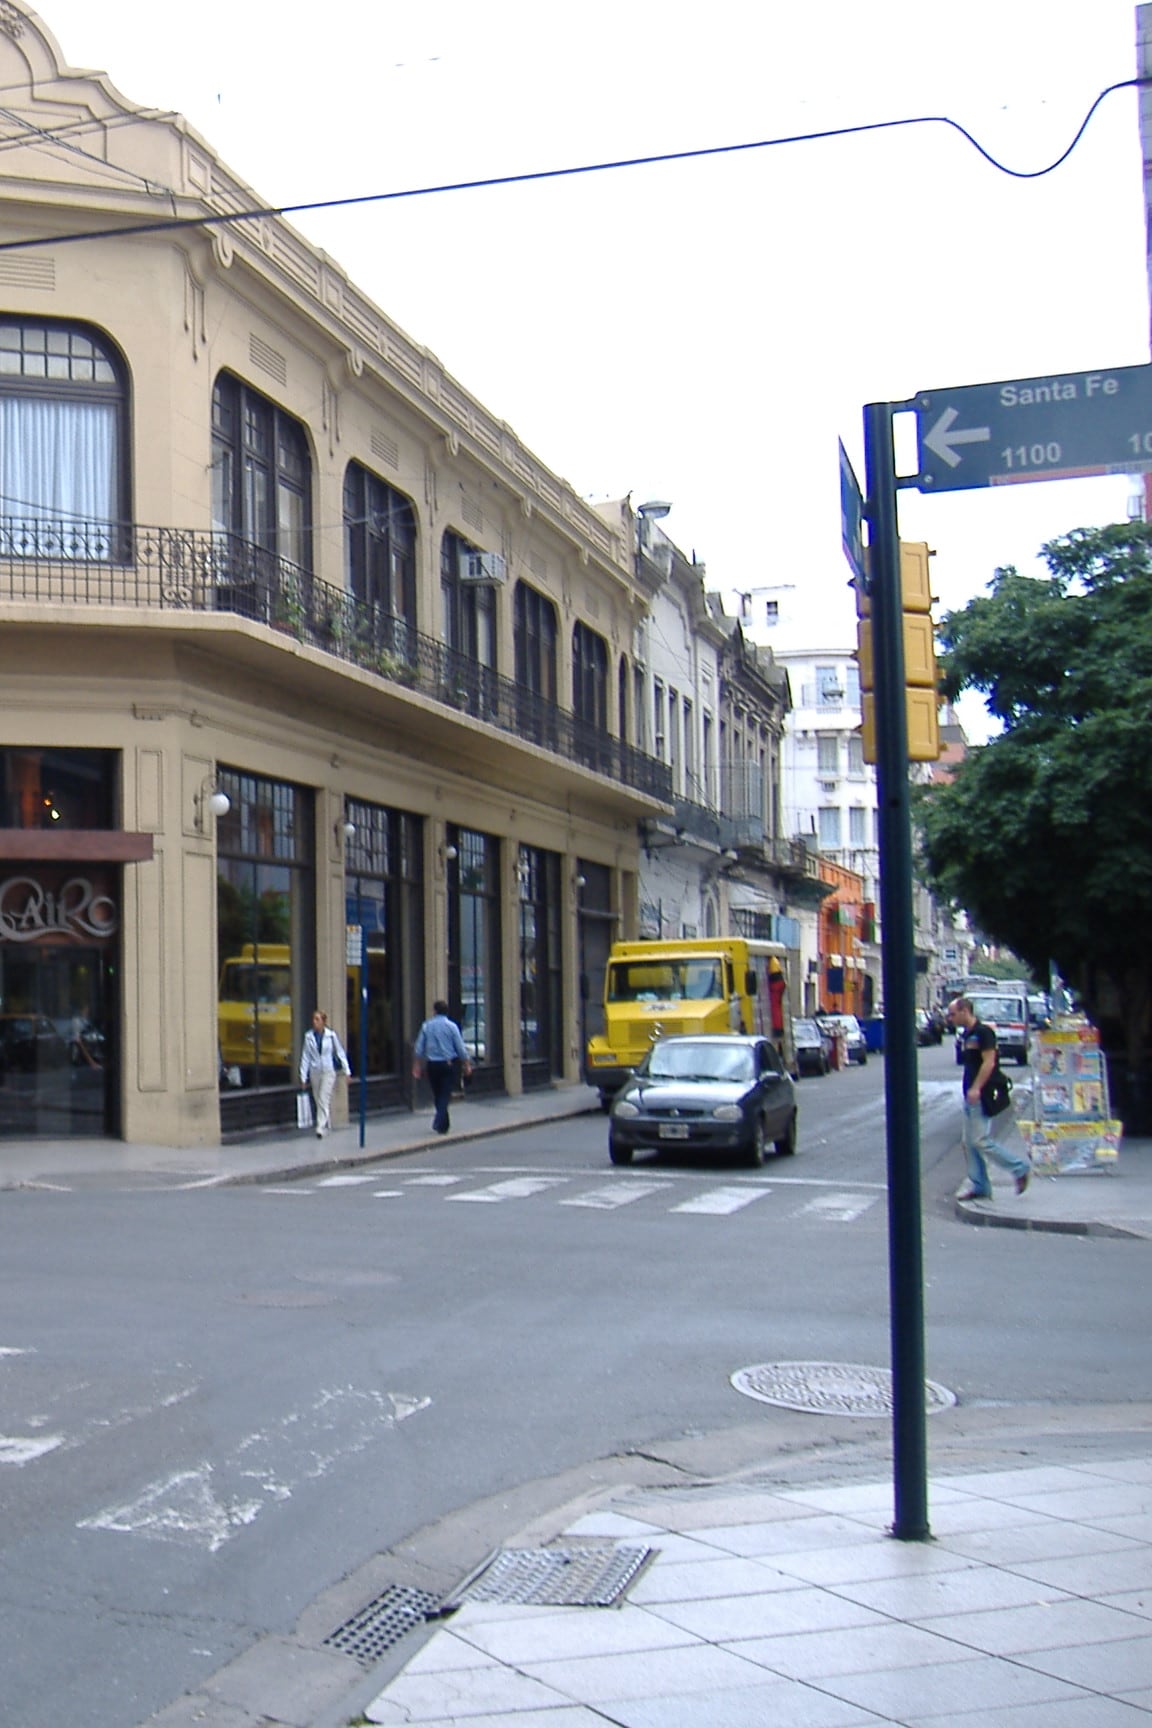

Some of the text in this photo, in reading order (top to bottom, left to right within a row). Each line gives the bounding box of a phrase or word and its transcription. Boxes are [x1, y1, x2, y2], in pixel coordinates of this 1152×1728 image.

[1000, 375, 1119, 407] Santa Fe
[1001, 442, 1061, 468] 1100
